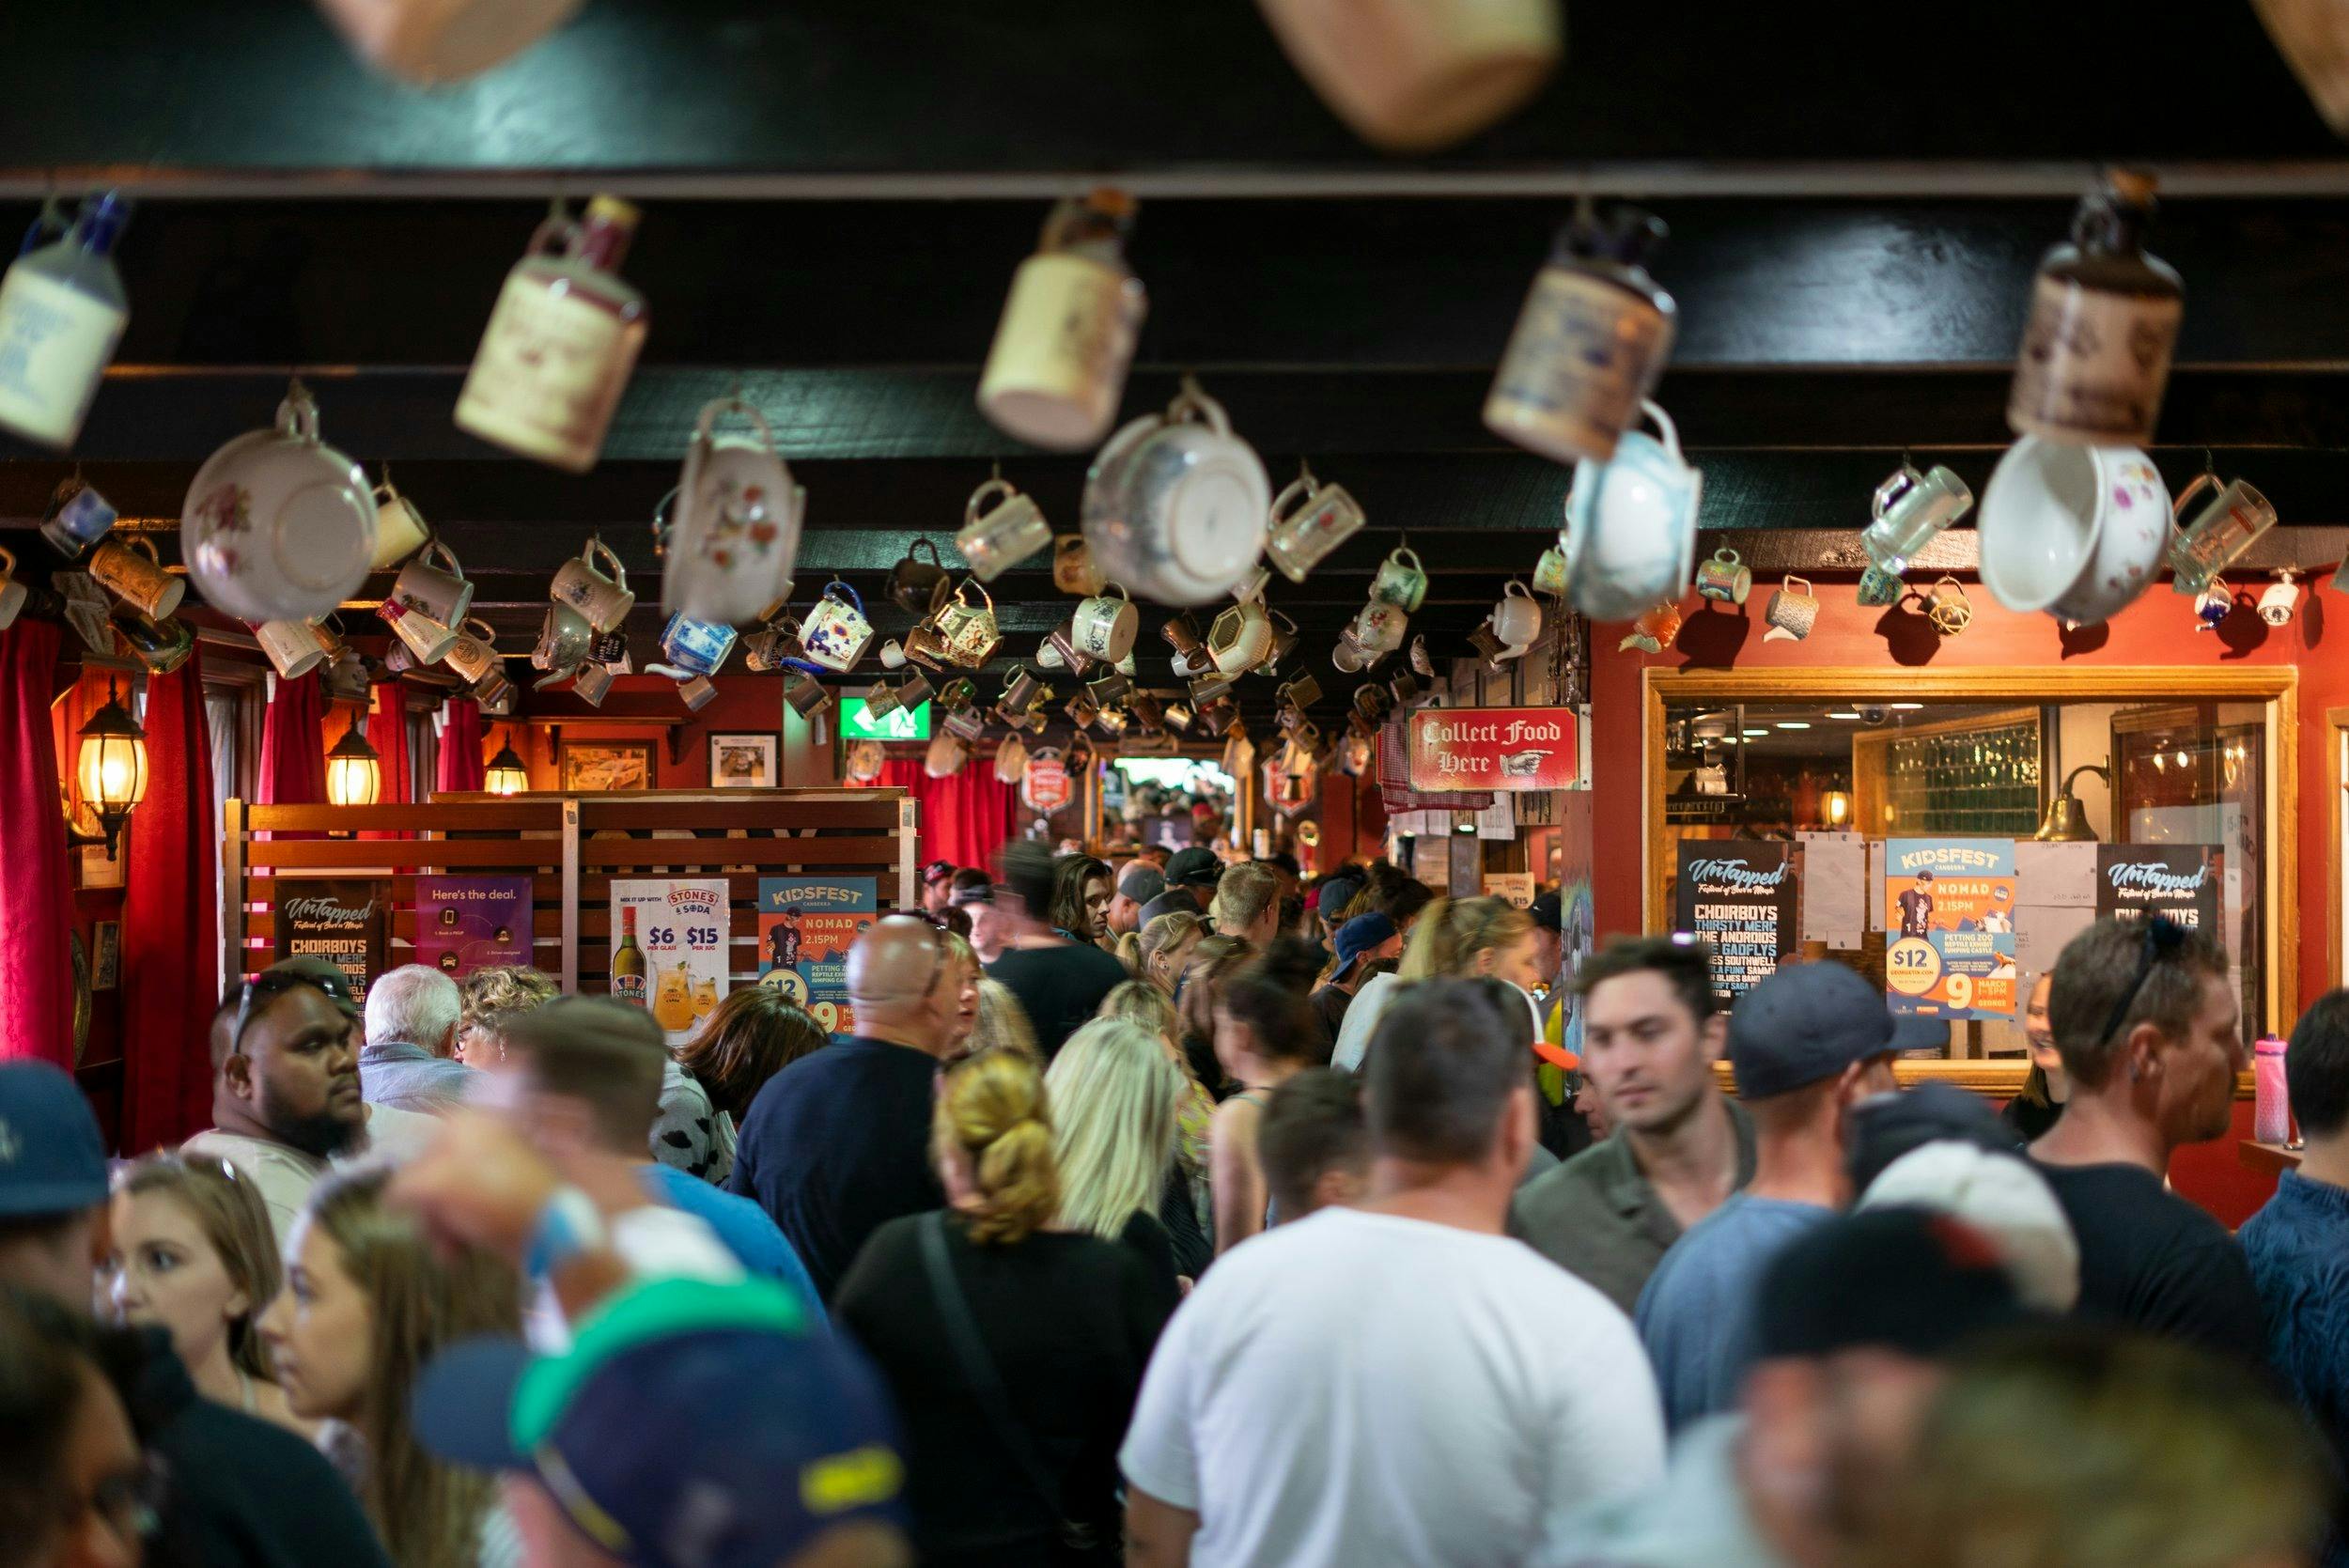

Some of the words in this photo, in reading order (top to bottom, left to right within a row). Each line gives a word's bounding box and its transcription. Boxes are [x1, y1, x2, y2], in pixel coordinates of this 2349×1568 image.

[1423, 721, 1498, 743] Collect
[1501, 720, 1561, 745] Food
[1439, 751, 1490, 777] Here
[1901, 848, 1999, 870] KIDSFEST
[1688, 859, 1785, 889] UnTapped
[2108, 862, 2206, 893] UnTapped
[432, 890, 466, 900] Here's
[468, 890, 486, 900] the
[489, 890, 516, 900] deal.
[1937, 884, 1989, 894] NOMAD
[670, 891, 715, 903] STONE'S
[772, 886, 863, 906] KIDSFEST
[285, 897, 374, 924] UnTapped
[684, 905, 710, 915] SODA
[1938, 901, 1973, 911] 2.15PM
[1695, 905, 1778, 921] CHOIRBOYS
[805, 919, 853, 928] NOMAD
[1695, 921, 1742, 931] THIRSTY
[1745, 921, 1778, 932] MERC
[649, 926, 675, 946] $6
[687, 926, 718, 946] $15
[805, 935, 838, 944] 2.15PM
[1695, 931, 1718, 943] THE
[1720, 931, 1777, 944] ANDROIDS
[1944, 933, 1975, 941] PETTING
[1978, 933, 1993, 941] ZOO
[291, 939, 366, 954] CHOIRBOYS
[1721, 943, 1777, 956] GADFLYS
[336, 954, 366, 964] MERC
[1725, 955, 1776, 966] SOUTHWELL
[1894, 949, 1927, 967] $12
[1724, 966, 1745, 974] FUNK
[1747, 966, 1776, 975] SAMMY
[1717, 974, 1740, 983] BLUES
[1741, 974, 1760, 983] BAND
[1946, 973, 1973, 1009] 9
[1978, 999, 2007, 1007] GEORGE
[813, 1001, 838, 1033] 9
